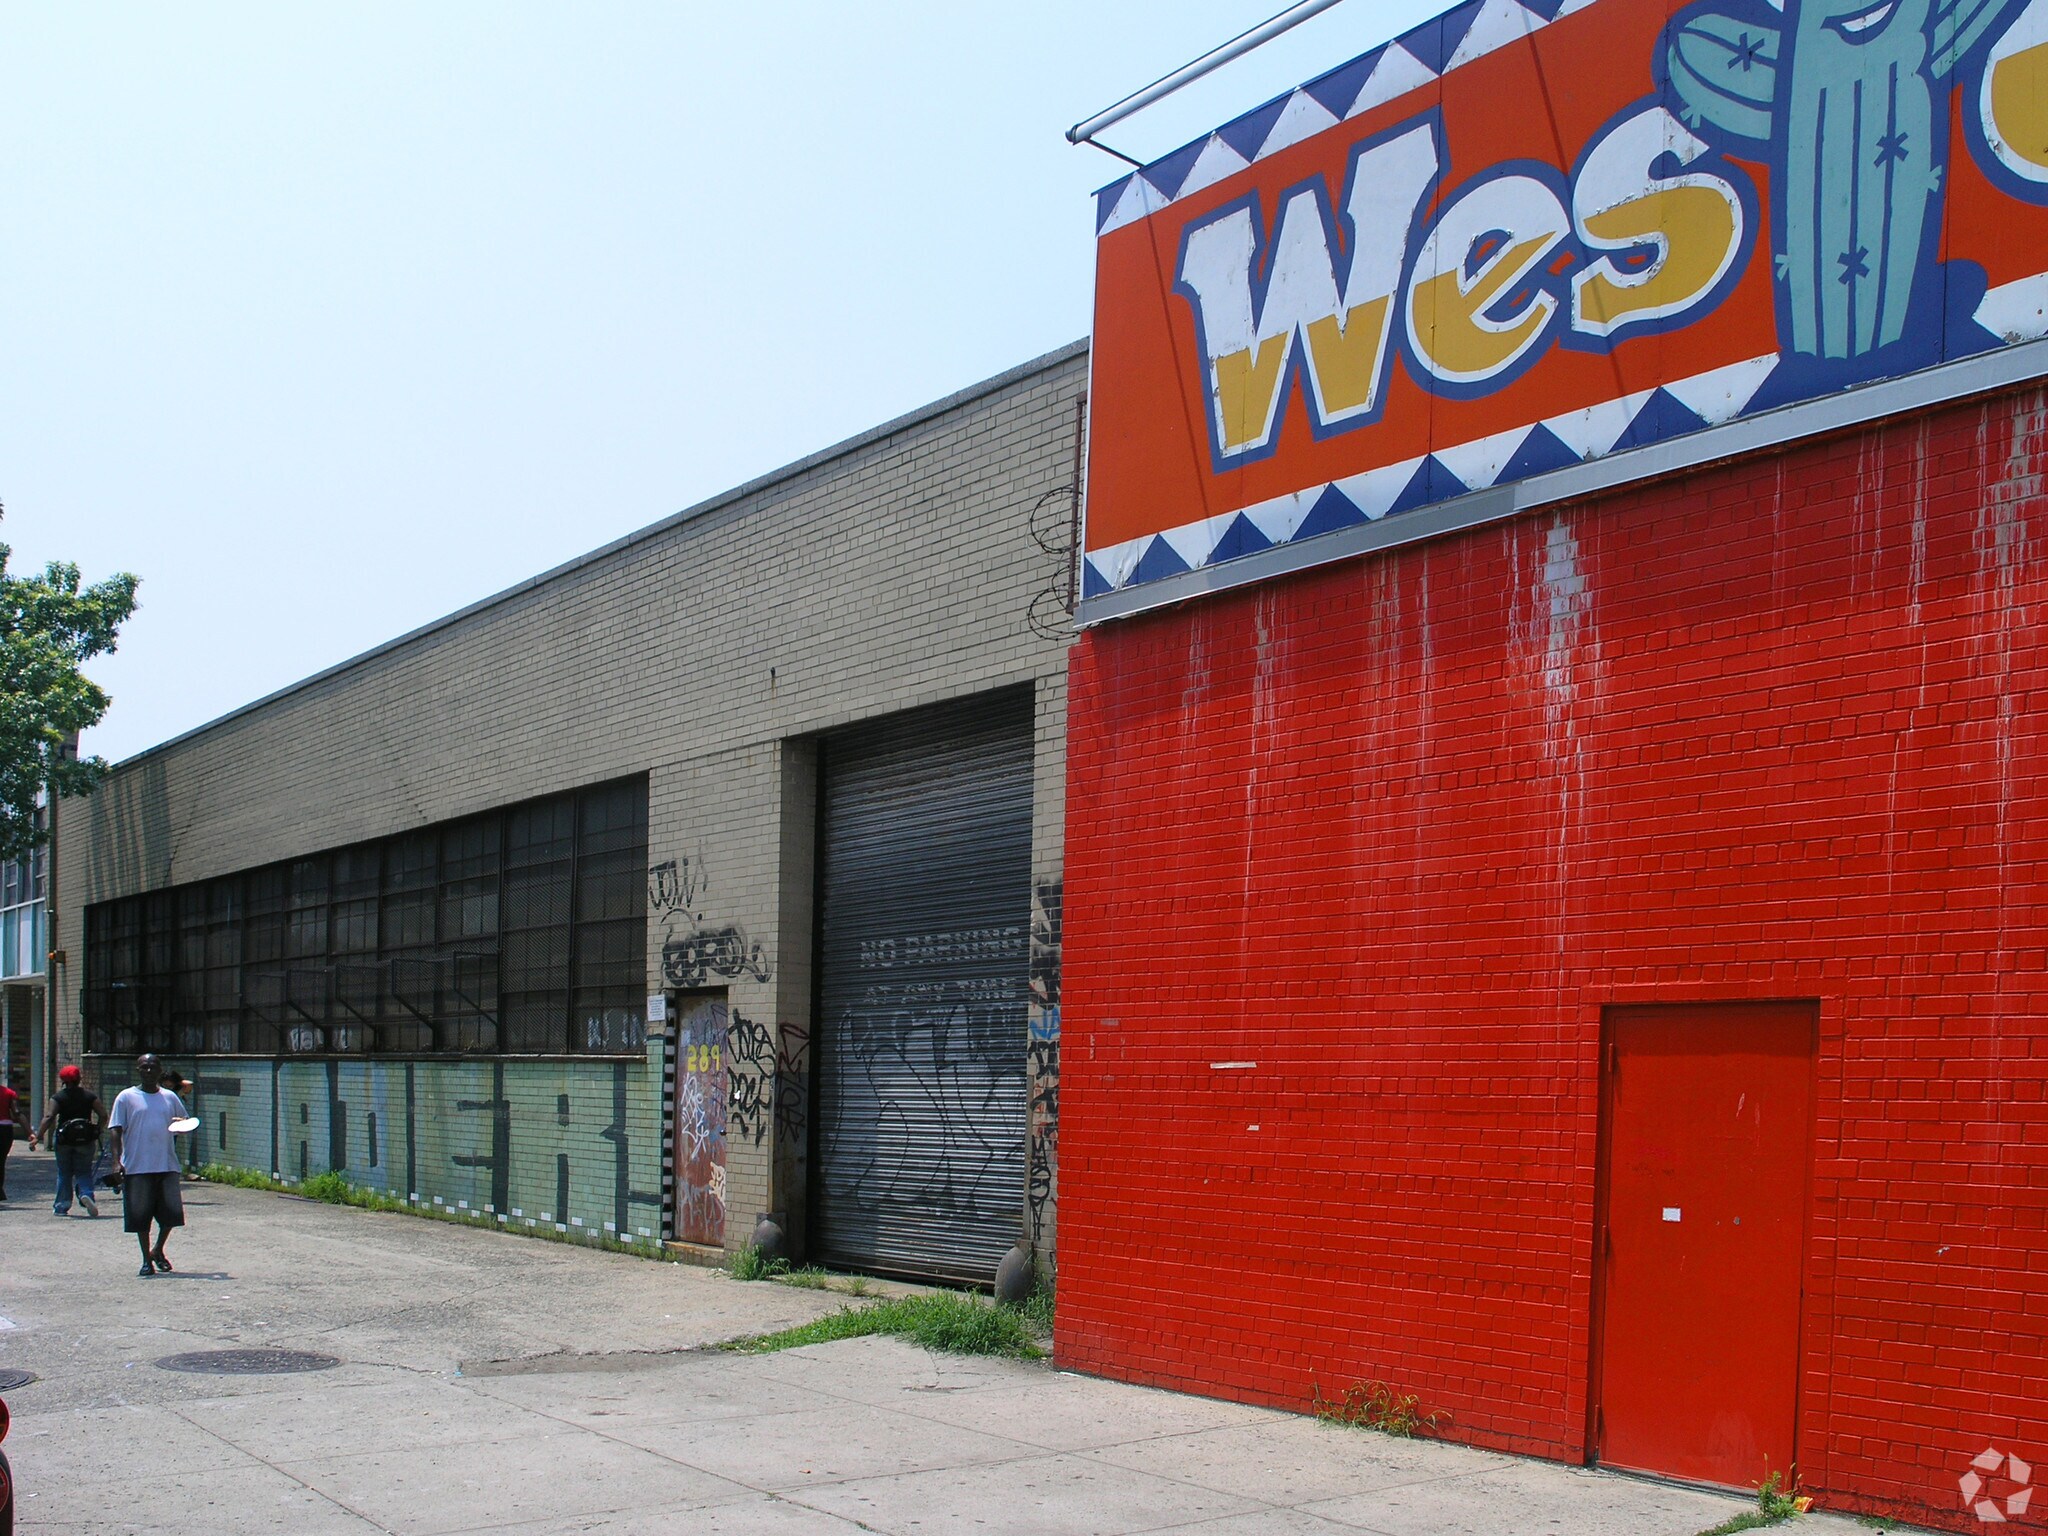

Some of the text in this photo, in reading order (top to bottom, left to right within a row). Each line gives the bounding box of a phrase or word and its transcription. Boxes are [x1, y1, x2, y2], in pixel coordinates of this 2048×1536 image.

[860, 927, 1020, 968] NO PARKING
[866, 976, 1017, 1005] AT ANY TIME
[688, 1044, 720, 1072] 289
